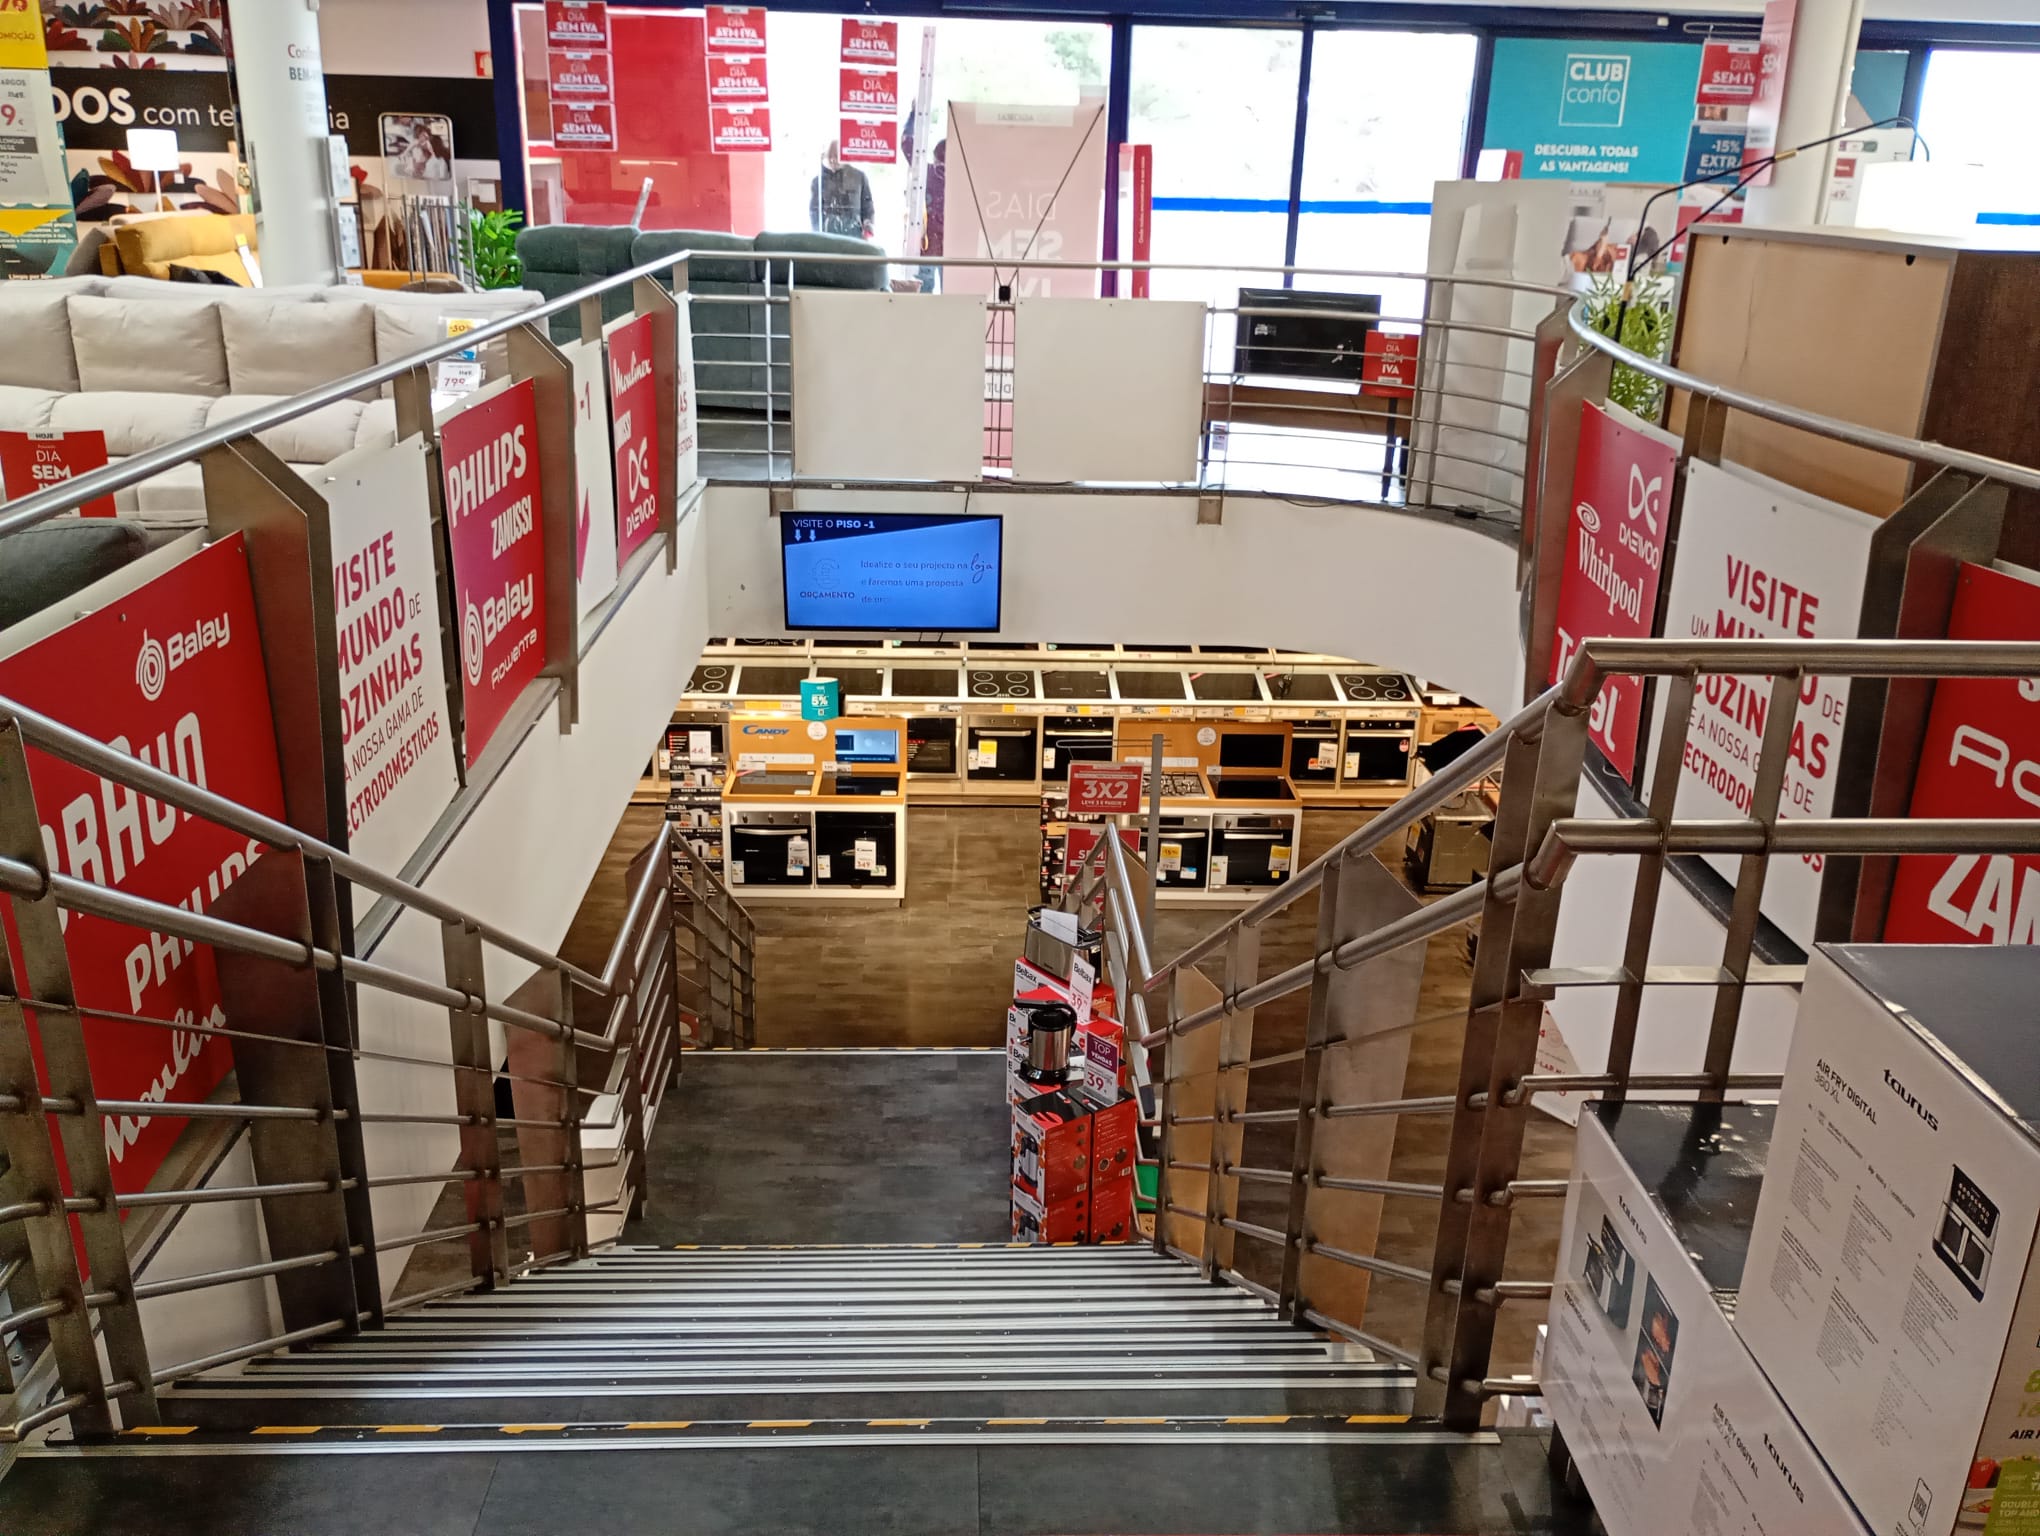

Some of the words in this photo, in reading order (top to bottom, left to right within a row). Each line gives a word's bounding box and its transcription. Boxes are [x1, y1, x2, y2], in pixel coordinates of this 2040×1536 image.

[861, 28, 878, 39] DIA
[849, 38, 872, 50] SEM
[873, 40, 889, 50] IVA
[1570, 62, 1624, 81] CLUB
[1730, 58, 1751, 70] DIA
[863, 80, 882, 90] DIA
[1712, 72, 1742, 84] SEM
[849, 90, 874, 102] SEM
[877, 92, 896, 103] IVA
[1566, 82, 1620, 104] confo
[143, 105, 200, 126] com
[860, 128, 877, 138] DIA
[848, 138, 872, 149] SEM
[872, 139, 888, 150] IVA
[1534, 144, 1597, 156] DESCUBRA
[1600, 146, 1639, 158] TODAS
[1712, 140, 1740, 154] -15%
[1540, 161, 1555, 172] AS
[1558, 162, 1629, 173] VANTAGENS!
[1386, 344, 1400, 352] DIA
[1382, 364, 1400, 374] IVA
[580, 380, 591, 420] -1
[36, 450, 62, 462] DIA
[32, 464, 72, 480] SEM
[448, 424, 527, 528] PHILIPS
[626, 494, 656, 538] DAEWOO
[792, 519, 823, 528] VISITE
[826, 520, 834, 528] O
[836, 520, 862, 528] PISO
[864, 520, 876, 528] -1
[491, 495, 533, 560] ZANUSSI
[1618, 522, 1659, 570] DAEWOO
[860, 560, 893, 569] Idealize
[920, 561, 955, 570] projecto
[970, 552, 993, 584] loja
[1578, 526, 1644, 624] Whirlpool
[868, 578, 903, 586] faremos
[926, 580, 964, 588] proposta
[800, 591, 855, 600] ORÇAMENTO
[1726, 554, 1820, 638] VISITE
[409, 592, 422, 620] DE
[483, 573, 534, 648] Balay
[166, 612, 232, 672] Balay
[1691, 614, 1709, 638] UM
[1822, 694, 1844, 726] DE
[340, 632, 422, 745] OZINHAS
[1556, 626, 1618, 752] Tal
[352, 728, 386, 776] NOSSA
[386, 703, 412, 740] GAMA
[412, 686, 424, 714] DE
[742, 725, 789, 735] CANDY
[1695, 675, 1830, 780] OZINAS
[1697, 713, 1706, 736] A
[1709, 720, 1749, 767] NOSSA
[1793, 782, 1814, 813] DE
[348, 711, 439, 840] CTRODOMÉSTICOS
[1082, 780, 1128, 800] 3X2
[1094, 1040, 1110, 1056] TOP
[1092, 1051, 1112, 1067] VENDAS
[1088, 1071, 1104, 1090] 39
[1814, 1071, 1830, 1093] 360
[1830, 1089, 1840, 1104] XL
[1816, 1058, 1830, 1078] AIR
[1831, 1071, 1847, 1092] FRY
[1847, 1087, 1876, 1126] DIGITAL
[1884, 1068, 1938, 1131] taurus
[2008, 1429, 2034, 1440] AIR
[1737, 1437, 1758, 1479] DIGITAL
[1764, 1432, 1804, 1504] taurus
